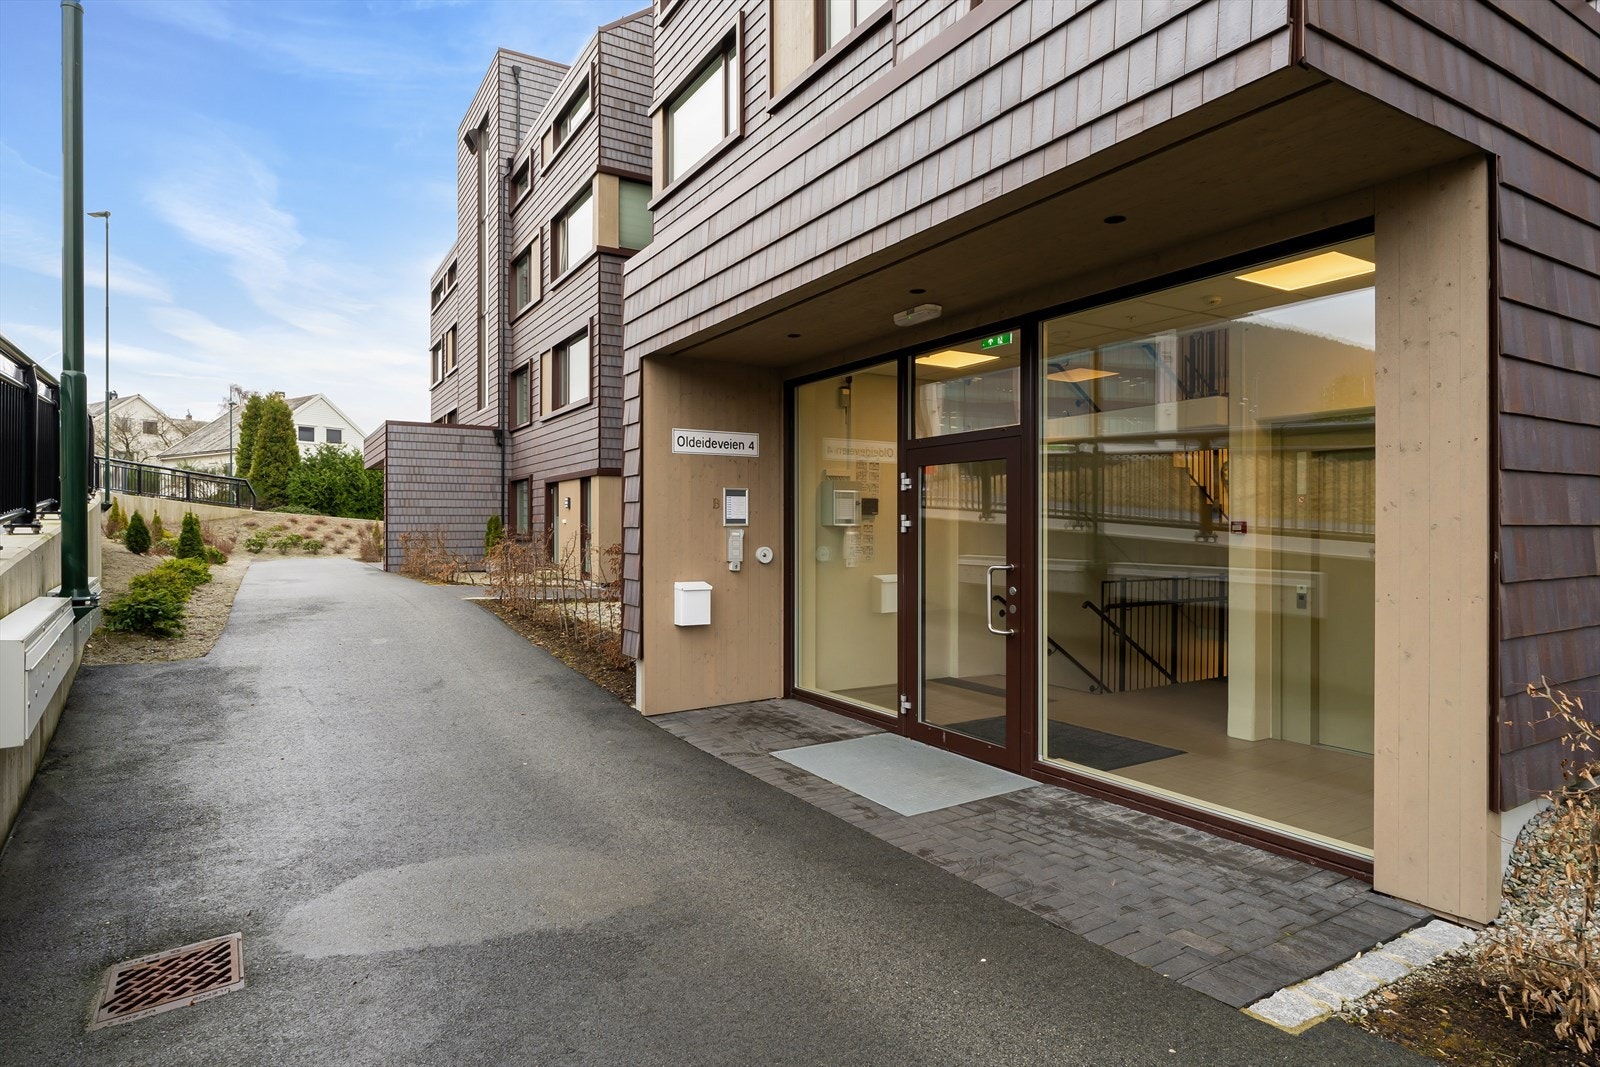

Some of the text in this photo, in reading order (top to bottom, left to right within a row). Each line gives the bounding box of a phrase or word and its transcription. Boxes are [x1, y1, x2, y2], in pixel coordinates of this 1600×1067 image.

[676, 435, 755, 451] Oldeideveien 4
[713, 498, 720, 509] B
